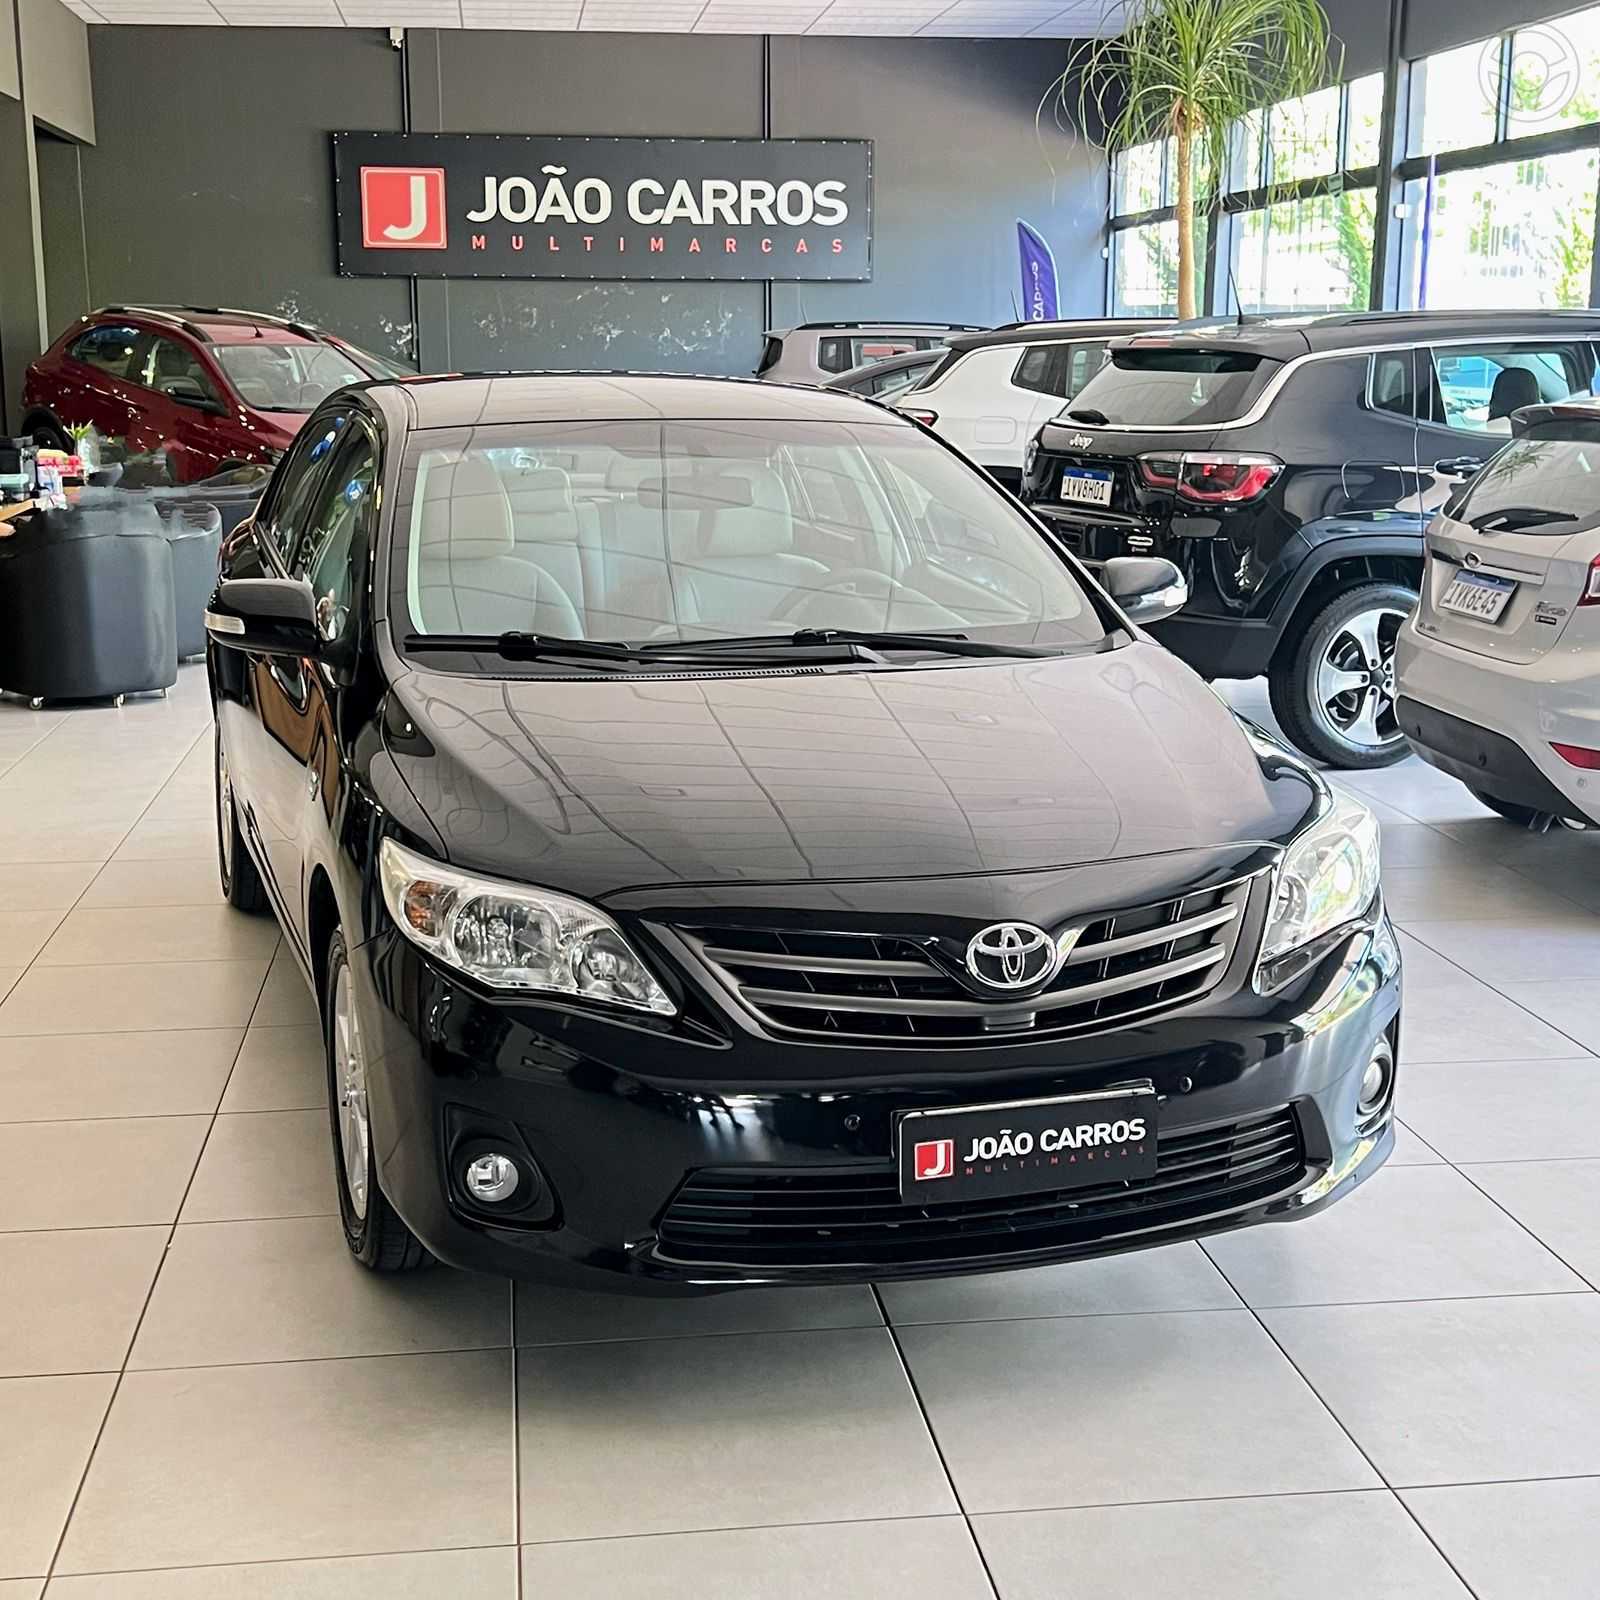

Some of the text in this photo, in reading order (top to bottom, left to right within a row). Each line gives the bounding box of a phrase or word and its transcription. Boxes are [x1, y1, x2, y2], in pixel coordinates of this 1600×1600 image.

[384, 176, 428, 241] J
[466, 164, 849, 227] JOÃO CARROS
[472, 235, 844, 254] MULTIMARCAS
[922, 1142, 946, 1176] J
[963, 1118, 1147, 1163] JOÃO CARROS
[966, 1145, 1145, 1175] MULTIMARCAS
